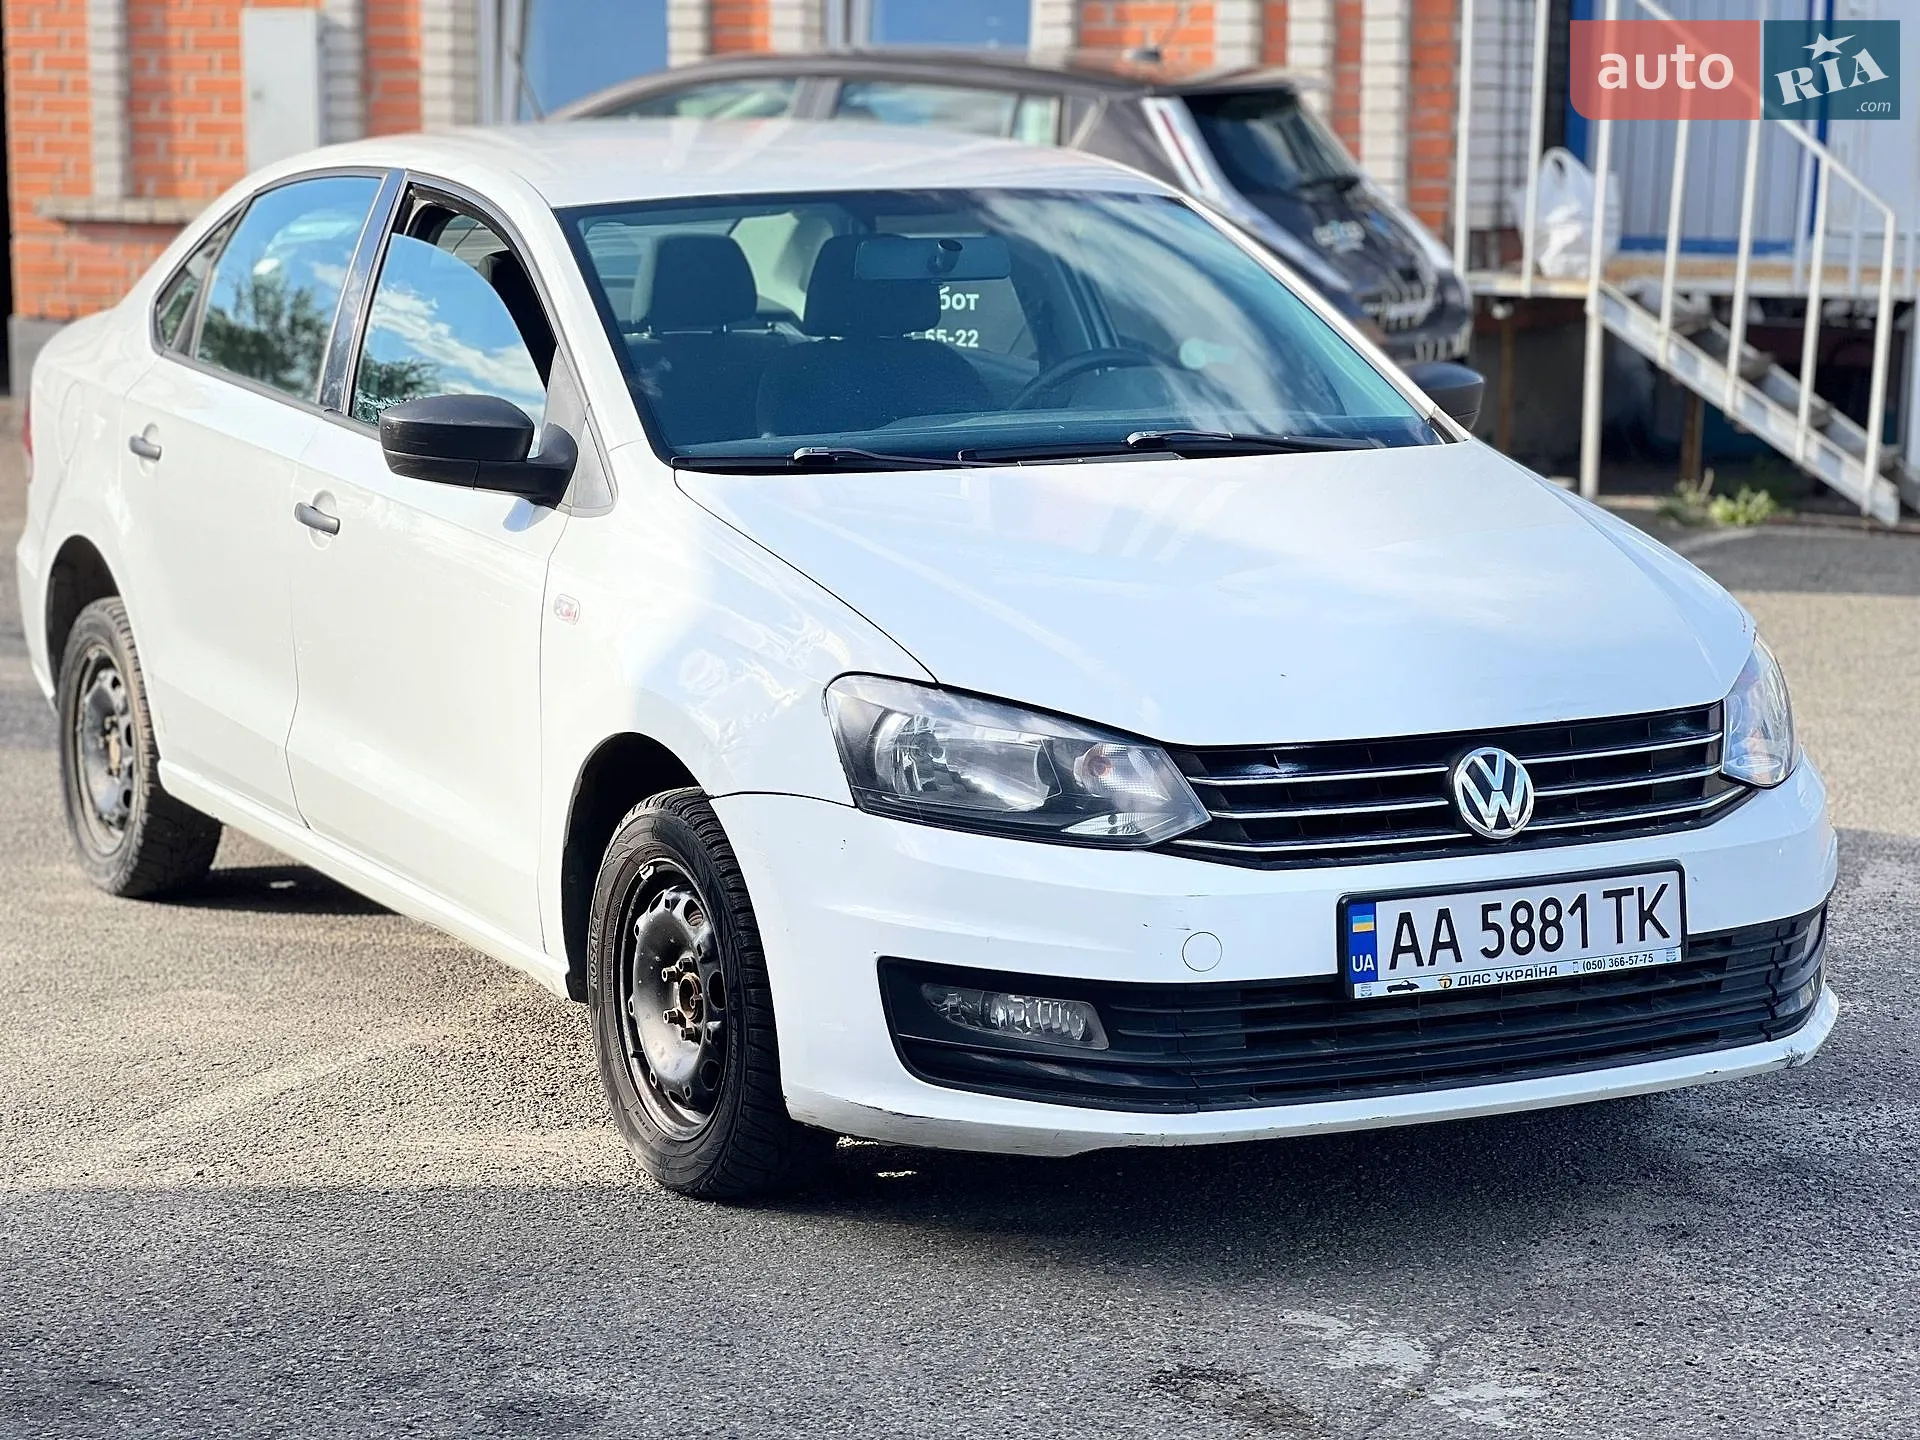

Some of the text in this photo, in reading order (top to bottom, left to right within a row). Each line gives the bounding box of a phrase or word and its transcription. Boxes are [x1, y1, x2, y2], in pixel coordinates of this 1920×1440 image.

[1389, 883, 1671, 970] AA 5881 TK
[1352, 954, 1375, 972] UA
[1458, 972, 1491, 987] ДІАС
[1495, 964, 1558, 983] УКРАЇНА
[1582, 958, 1606, 973] (050)
[1608, 952, 1654, 969] 366-57-75
